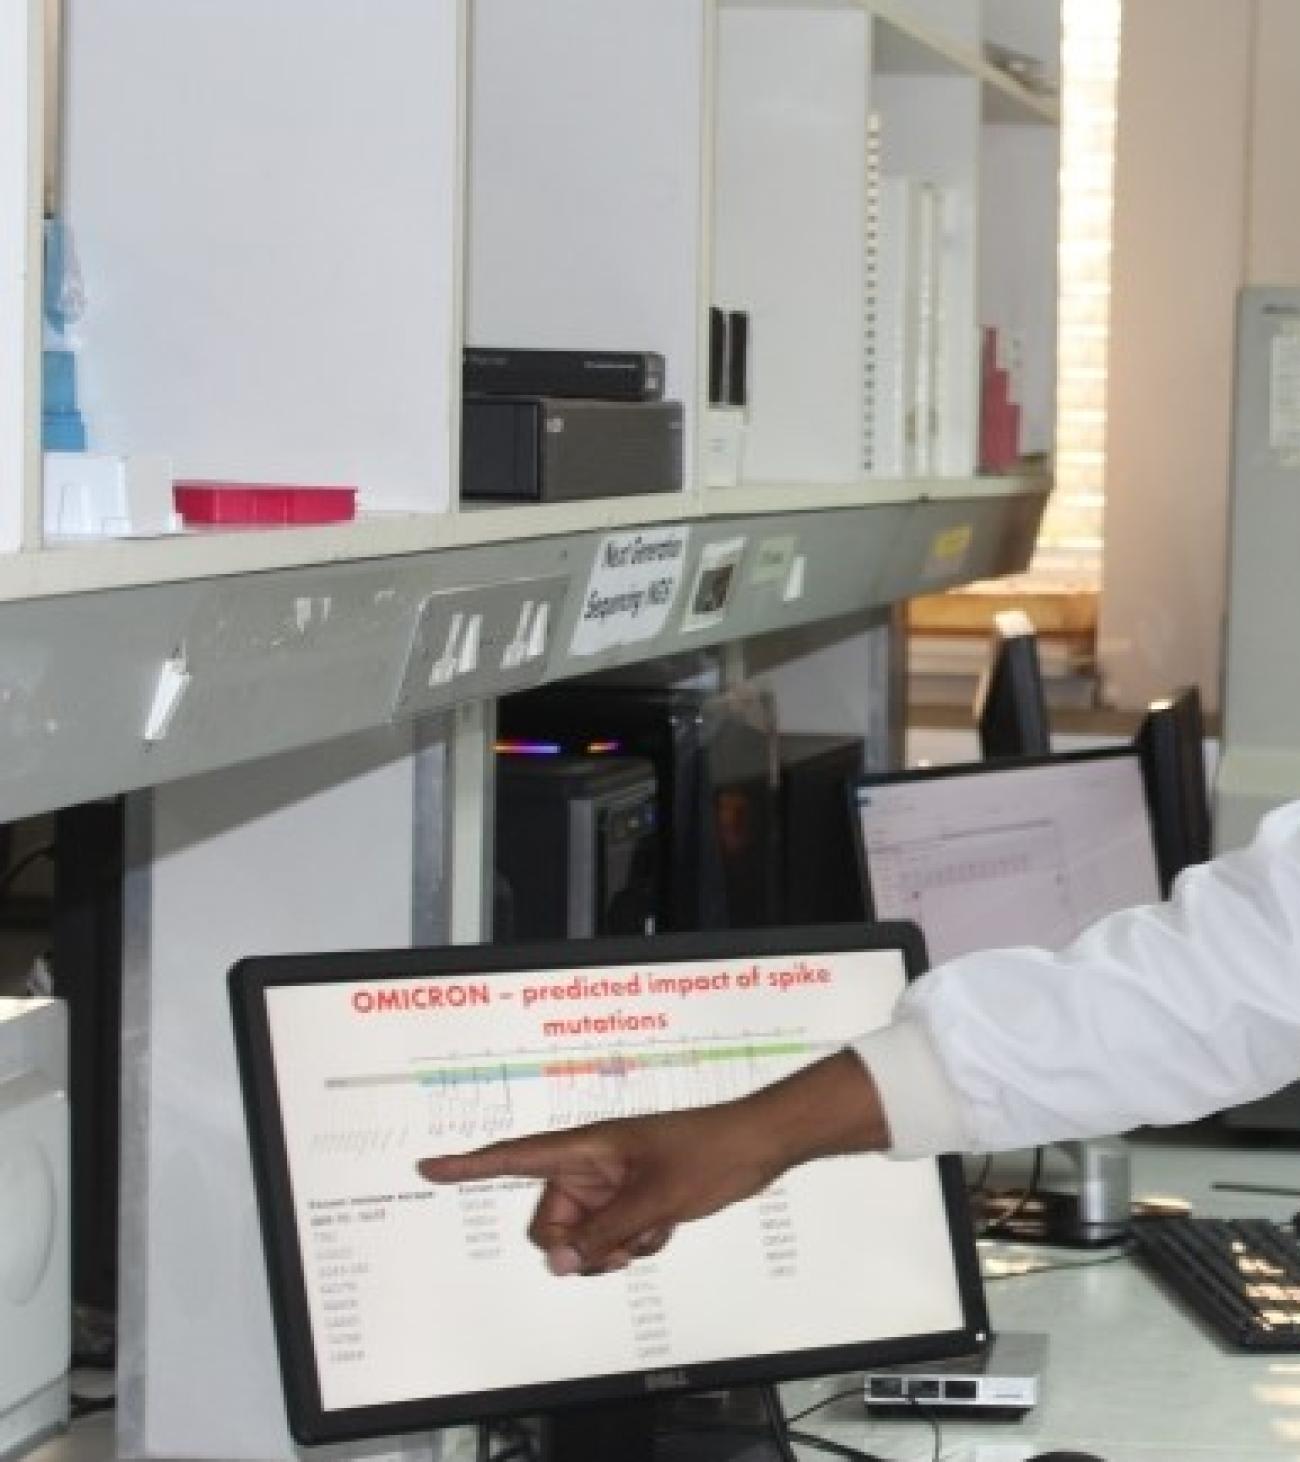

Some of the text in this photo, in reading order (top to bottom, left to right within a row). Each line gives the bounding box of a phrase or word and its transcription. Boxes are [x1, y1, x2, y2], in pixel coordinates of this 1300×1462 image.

[351, 983, 490, 1014] OMICRON
[522, 972, 641, 1007] predicted
[648, 971, 729, 998] impact
[736, 965, 760, 987] of
[768, 961, 832, 990] spike
[542, 1010, 669, 1037] mutations
